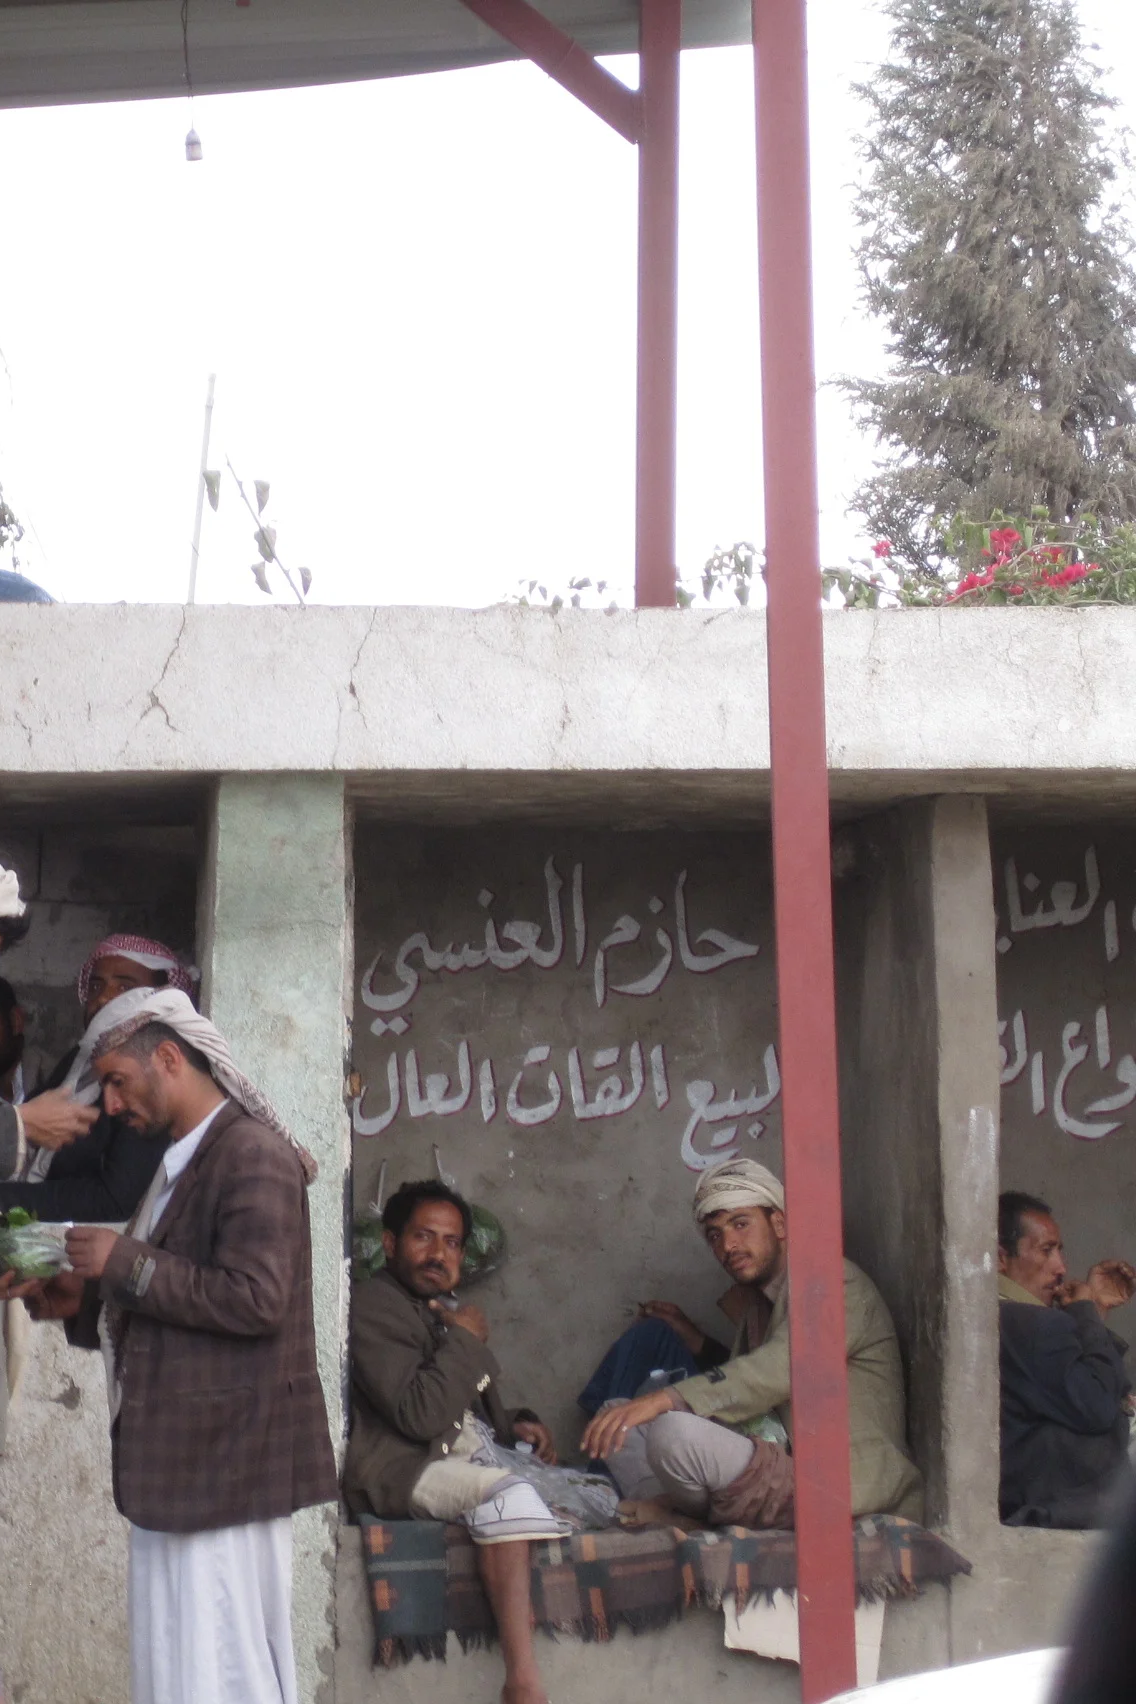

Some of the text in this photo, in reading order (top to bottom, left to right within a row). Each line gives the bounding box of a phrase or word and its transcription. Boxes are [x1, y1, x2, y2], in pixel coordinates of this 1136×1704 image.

[360, 854, 761, 1036] حازم العنسي
[505, 1040, 670, 1126] القات
[679, 1043, 782, 1171] لبيع
